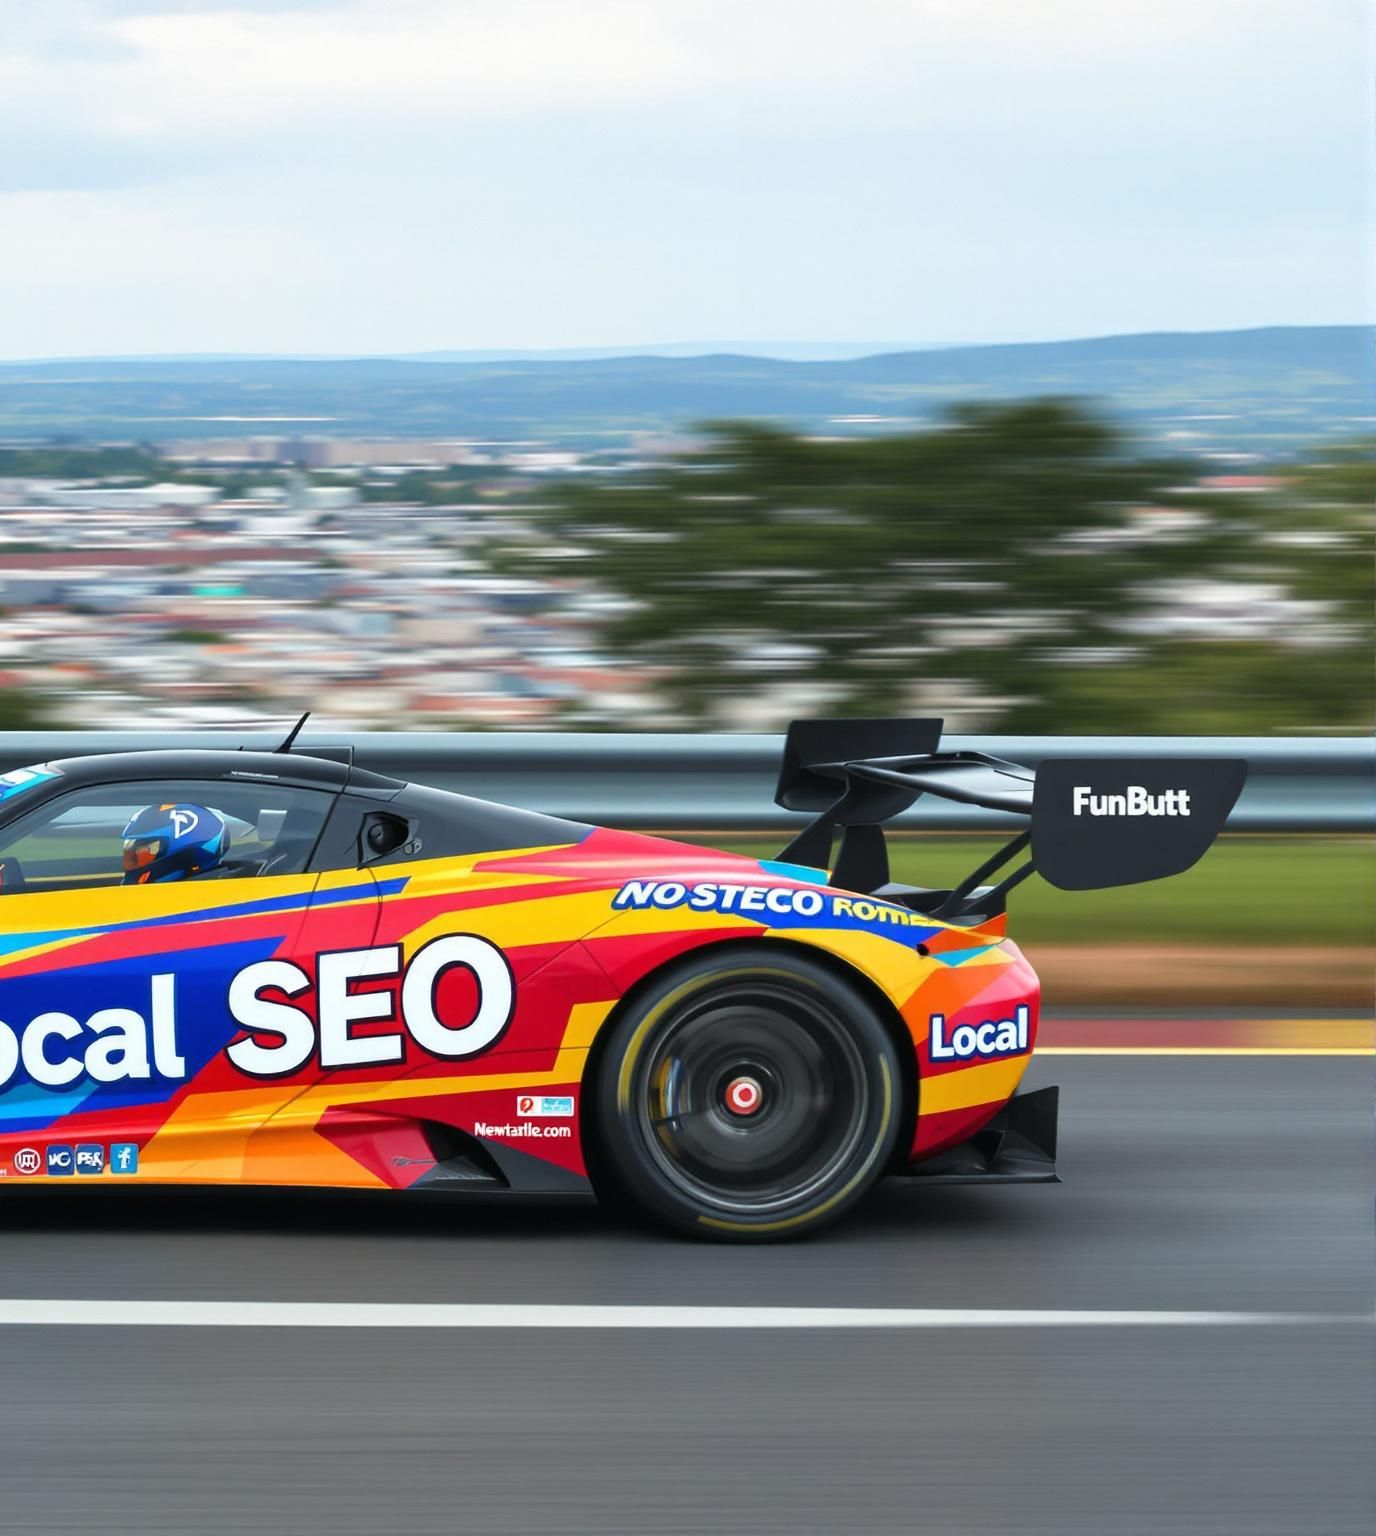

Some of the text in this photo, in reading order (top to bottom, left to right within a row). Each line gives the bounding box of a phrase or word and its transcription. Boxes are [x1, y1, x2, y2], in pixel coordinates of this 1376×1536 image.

[1072, 785, 1191, 817] FunButt
[614, 881, 686, 906] NO
[690, 883, 824, 916] STECO
[226, 932, 516, 1079] SEO
[931, 1006, 1029, 1058] Local
